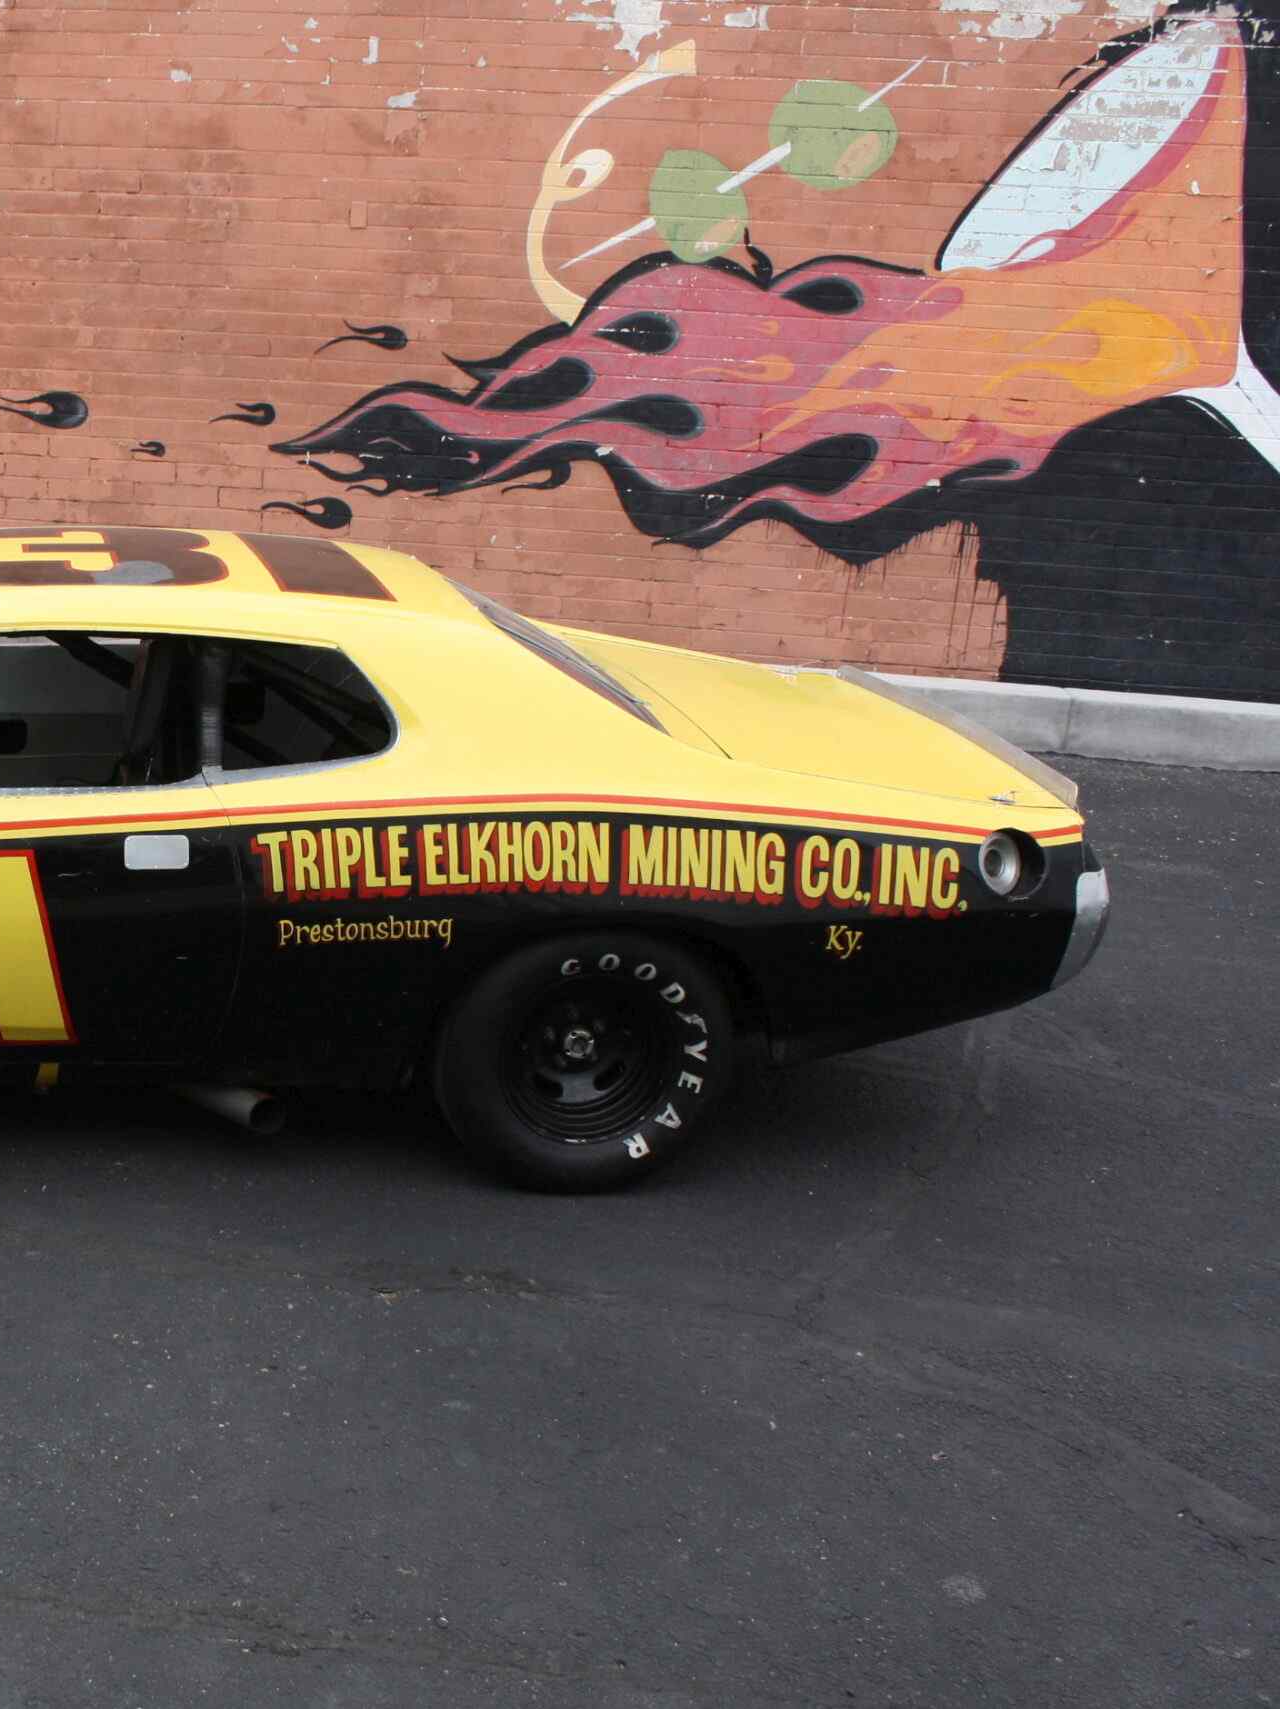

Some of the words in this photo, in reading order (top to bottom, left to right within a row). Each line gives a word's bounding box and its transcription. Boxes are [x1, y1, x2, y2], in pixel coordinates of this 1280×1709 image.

[253, 825, 412, 896] TRIPLE
[420, 821, 610, 894] ELKHORN
[623, 824, 786, 902] MINING
[278, 915, 454, 949] Prestonsburg
[825, 925, 863, 959] Ky.
